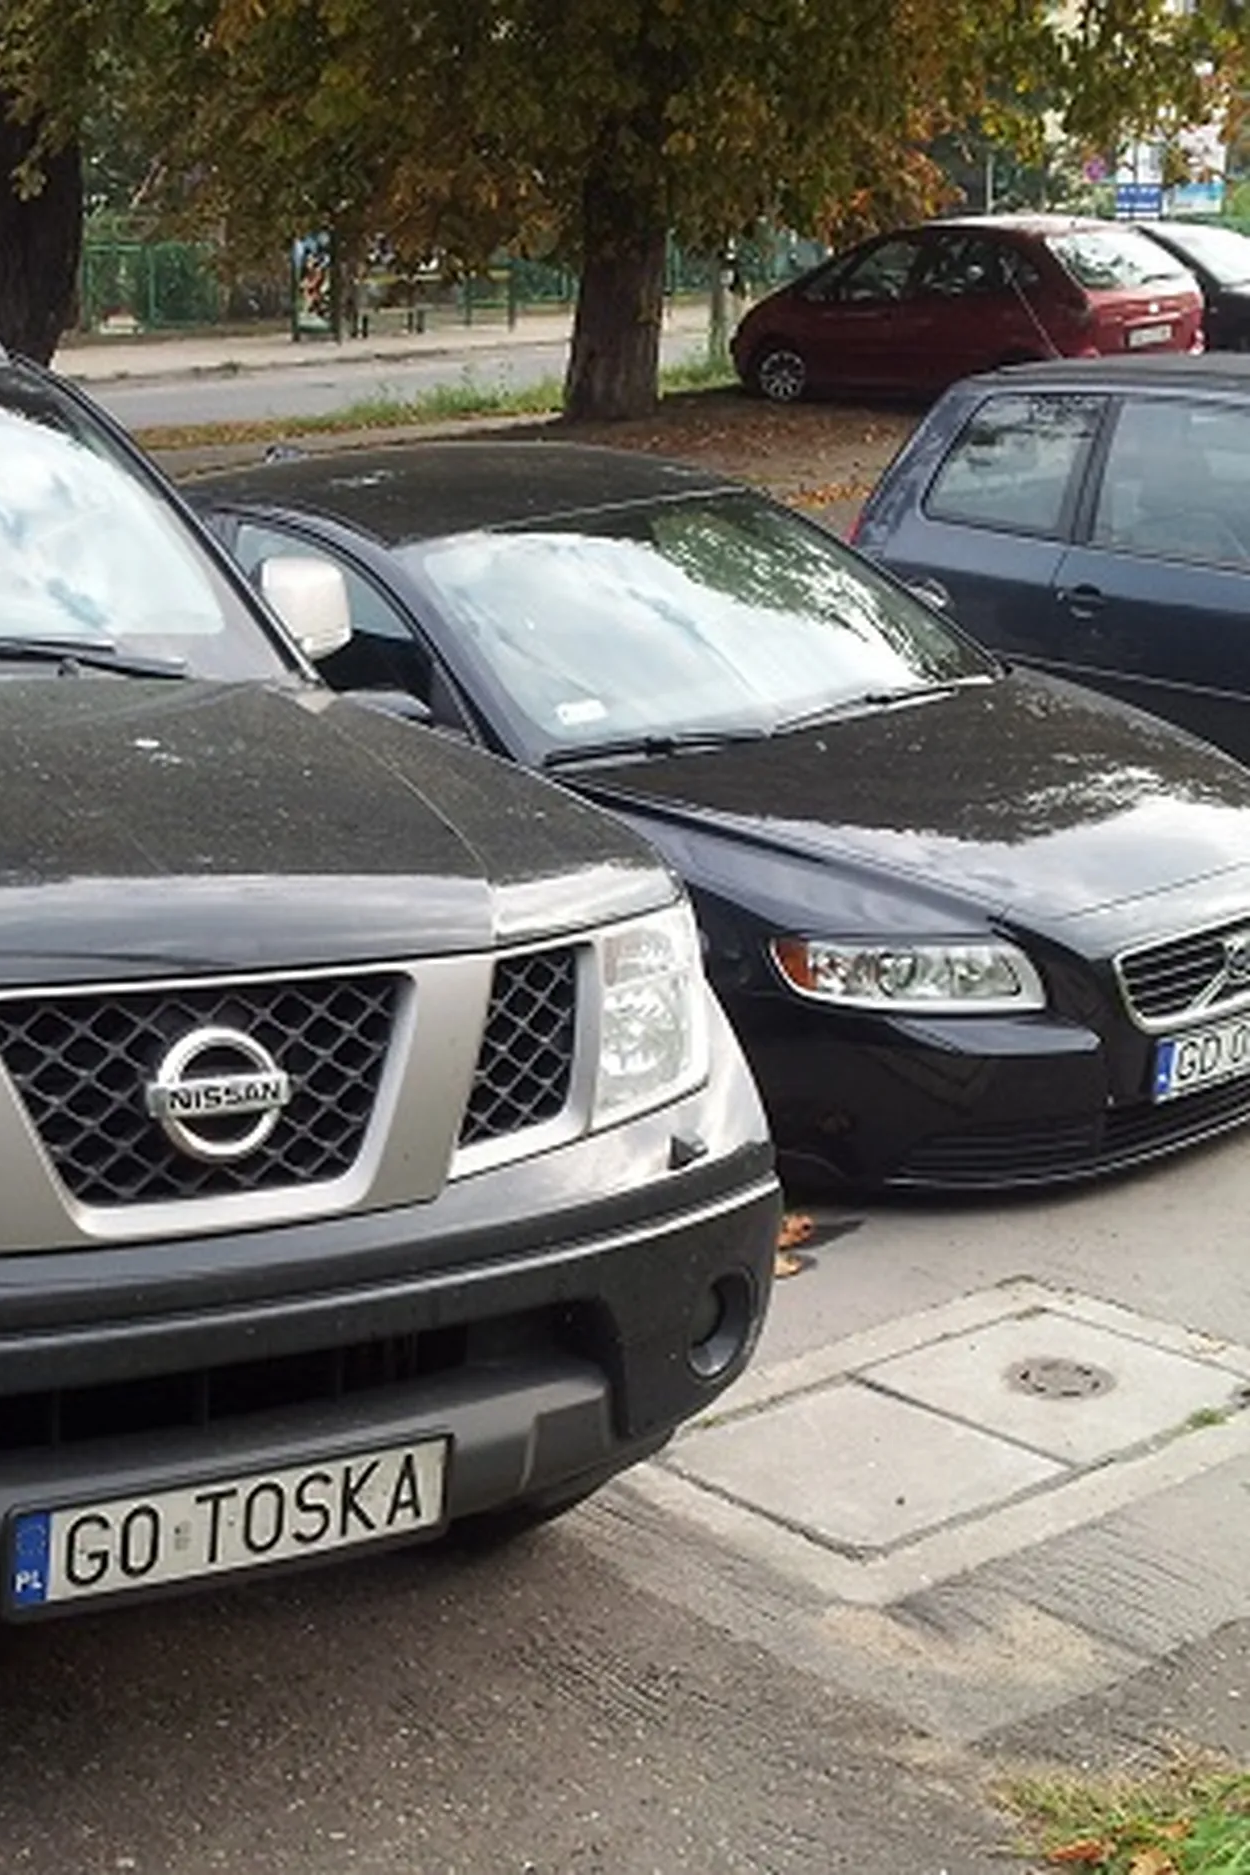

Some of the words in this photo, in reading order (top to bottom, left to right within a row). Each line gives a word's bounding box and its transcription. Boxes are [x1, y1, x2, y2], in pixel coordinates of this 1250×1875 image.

[169, 1080, 281, 1110] NISSAN
[195, 1453, 422, 1565] TOSKA
[15, 1570, 43, 1594] PL
